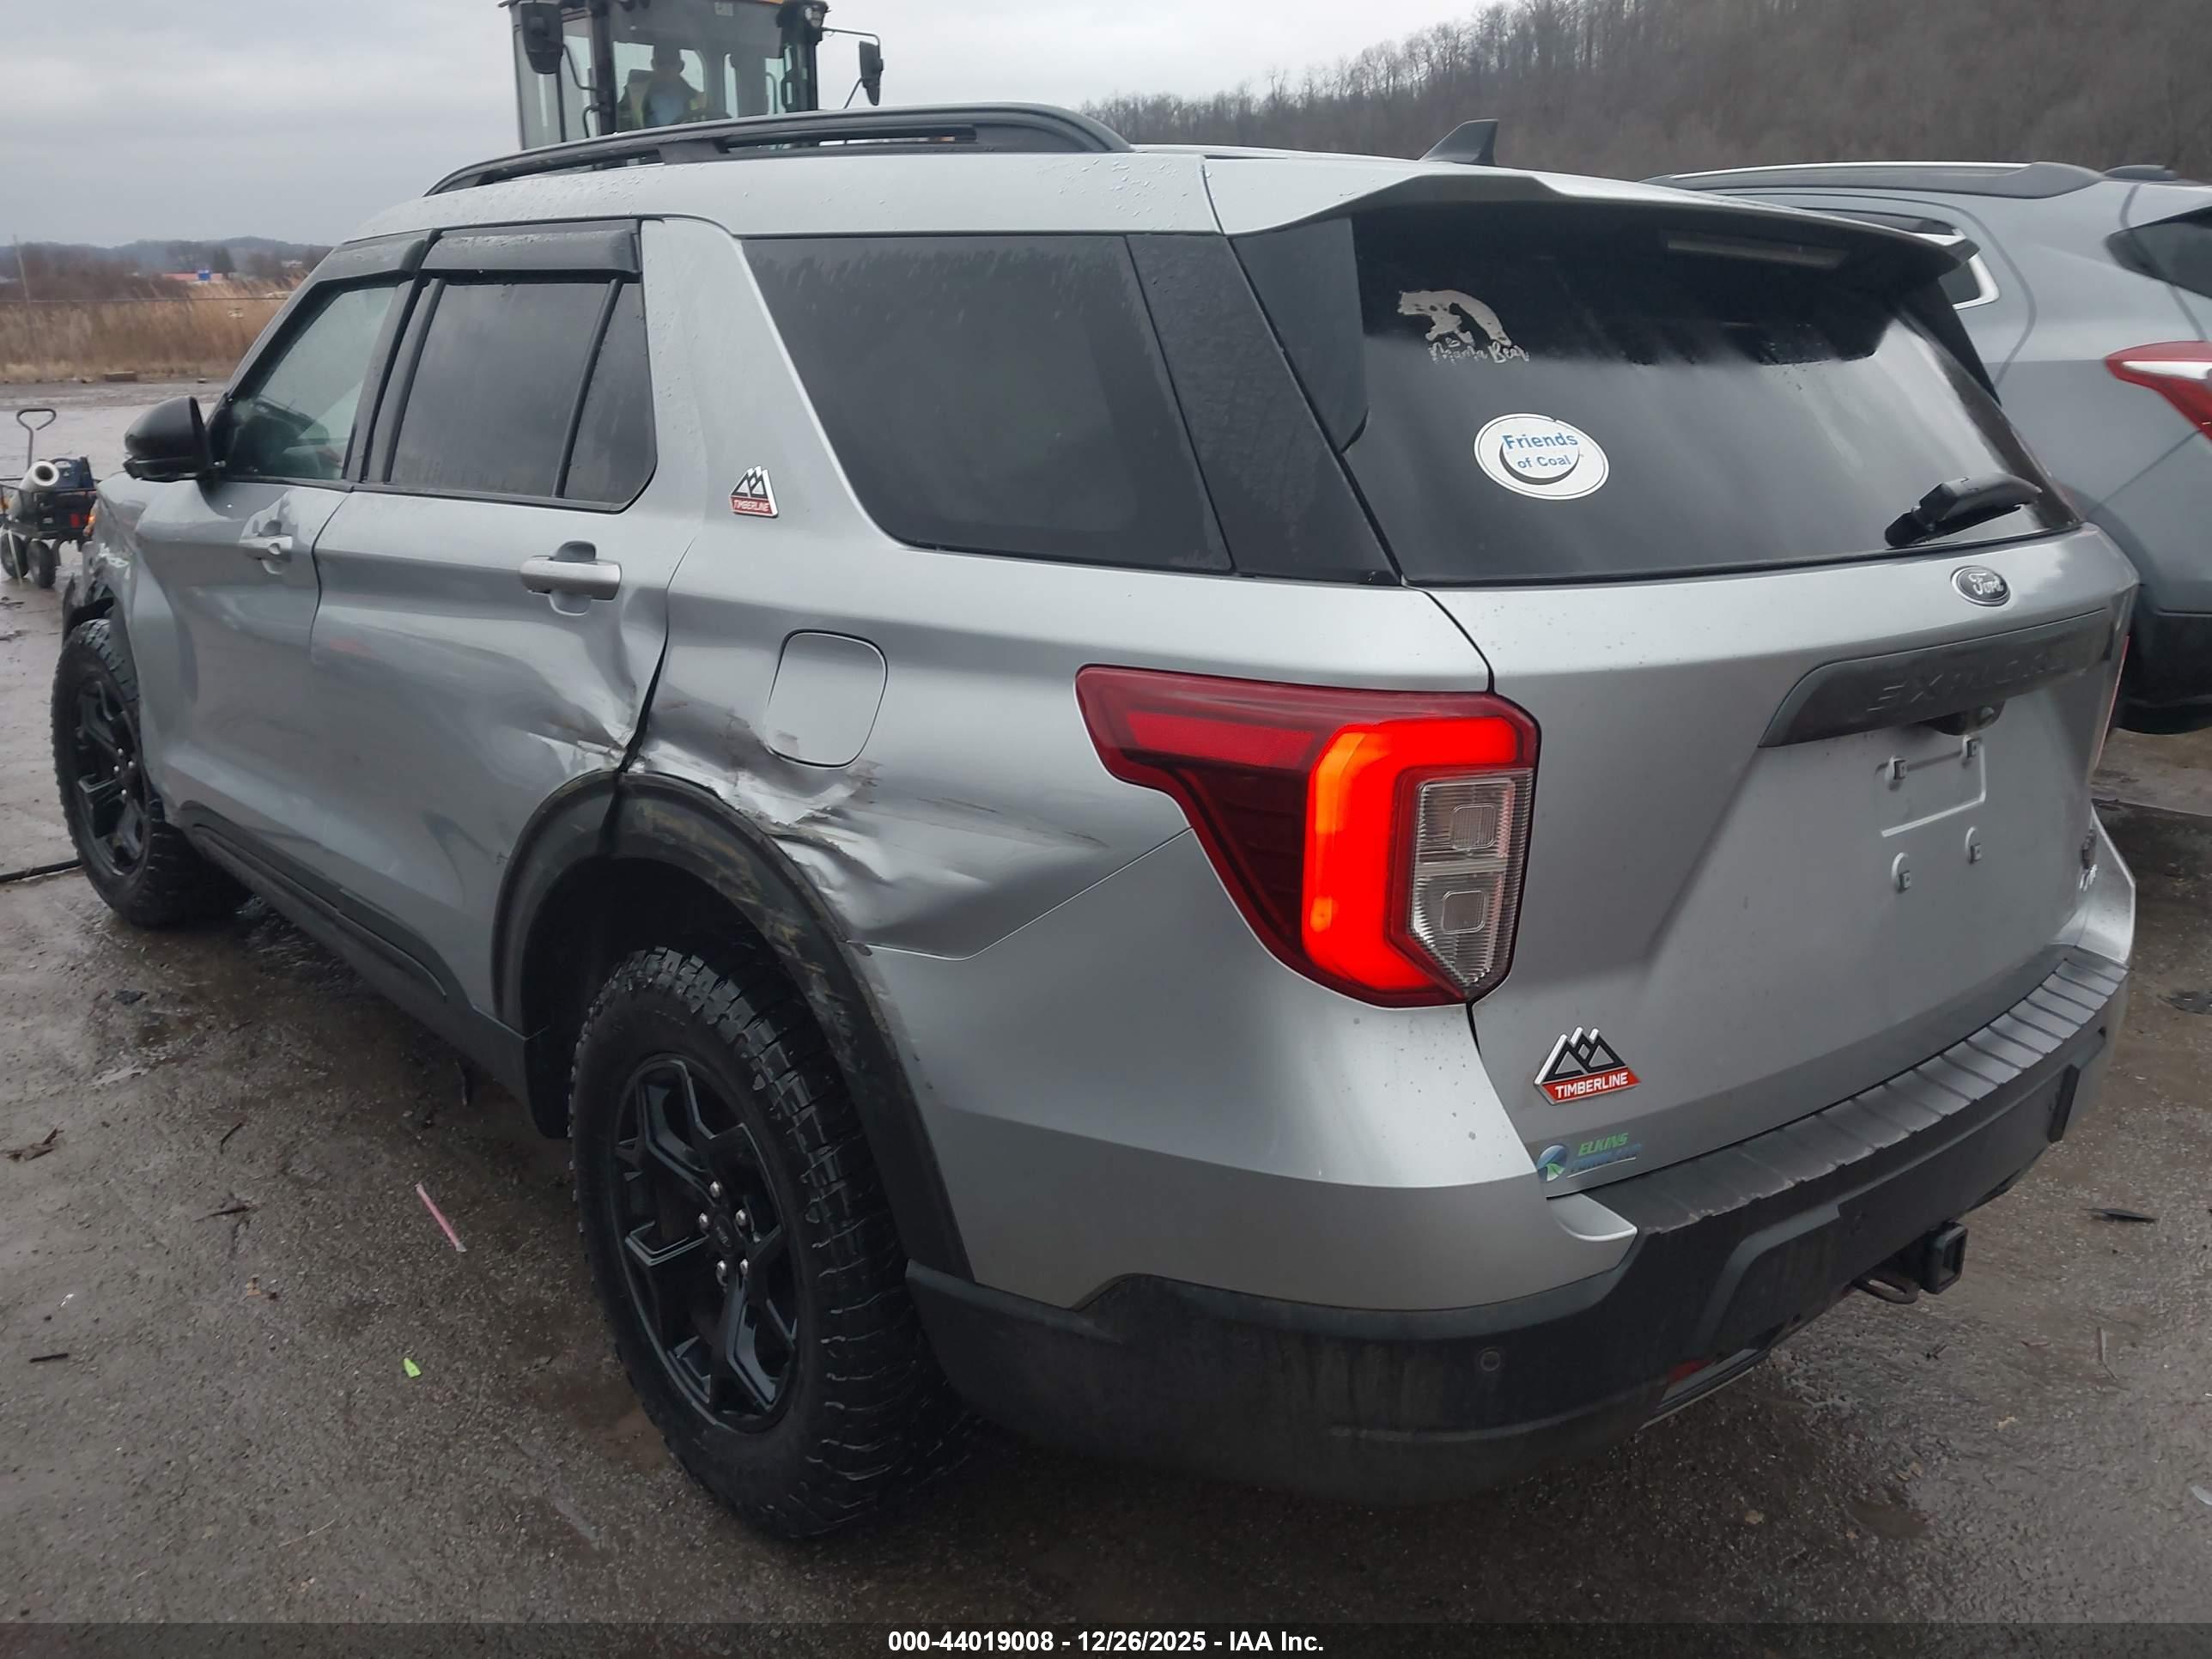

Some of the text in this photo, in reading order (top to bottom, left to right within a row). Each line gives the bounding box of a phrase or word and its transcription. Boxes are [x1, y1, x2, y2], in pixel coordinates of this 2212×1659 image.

[1503, 433, 1579, 450] Friends
[1517, 455, 1571, 469] of Coal
[1968, 573, 2004, 595] Ford
[1554, 1071, 1629, 1099] TIMBERLINE
[1578, 1133, 1629, 1157] ELKINS
